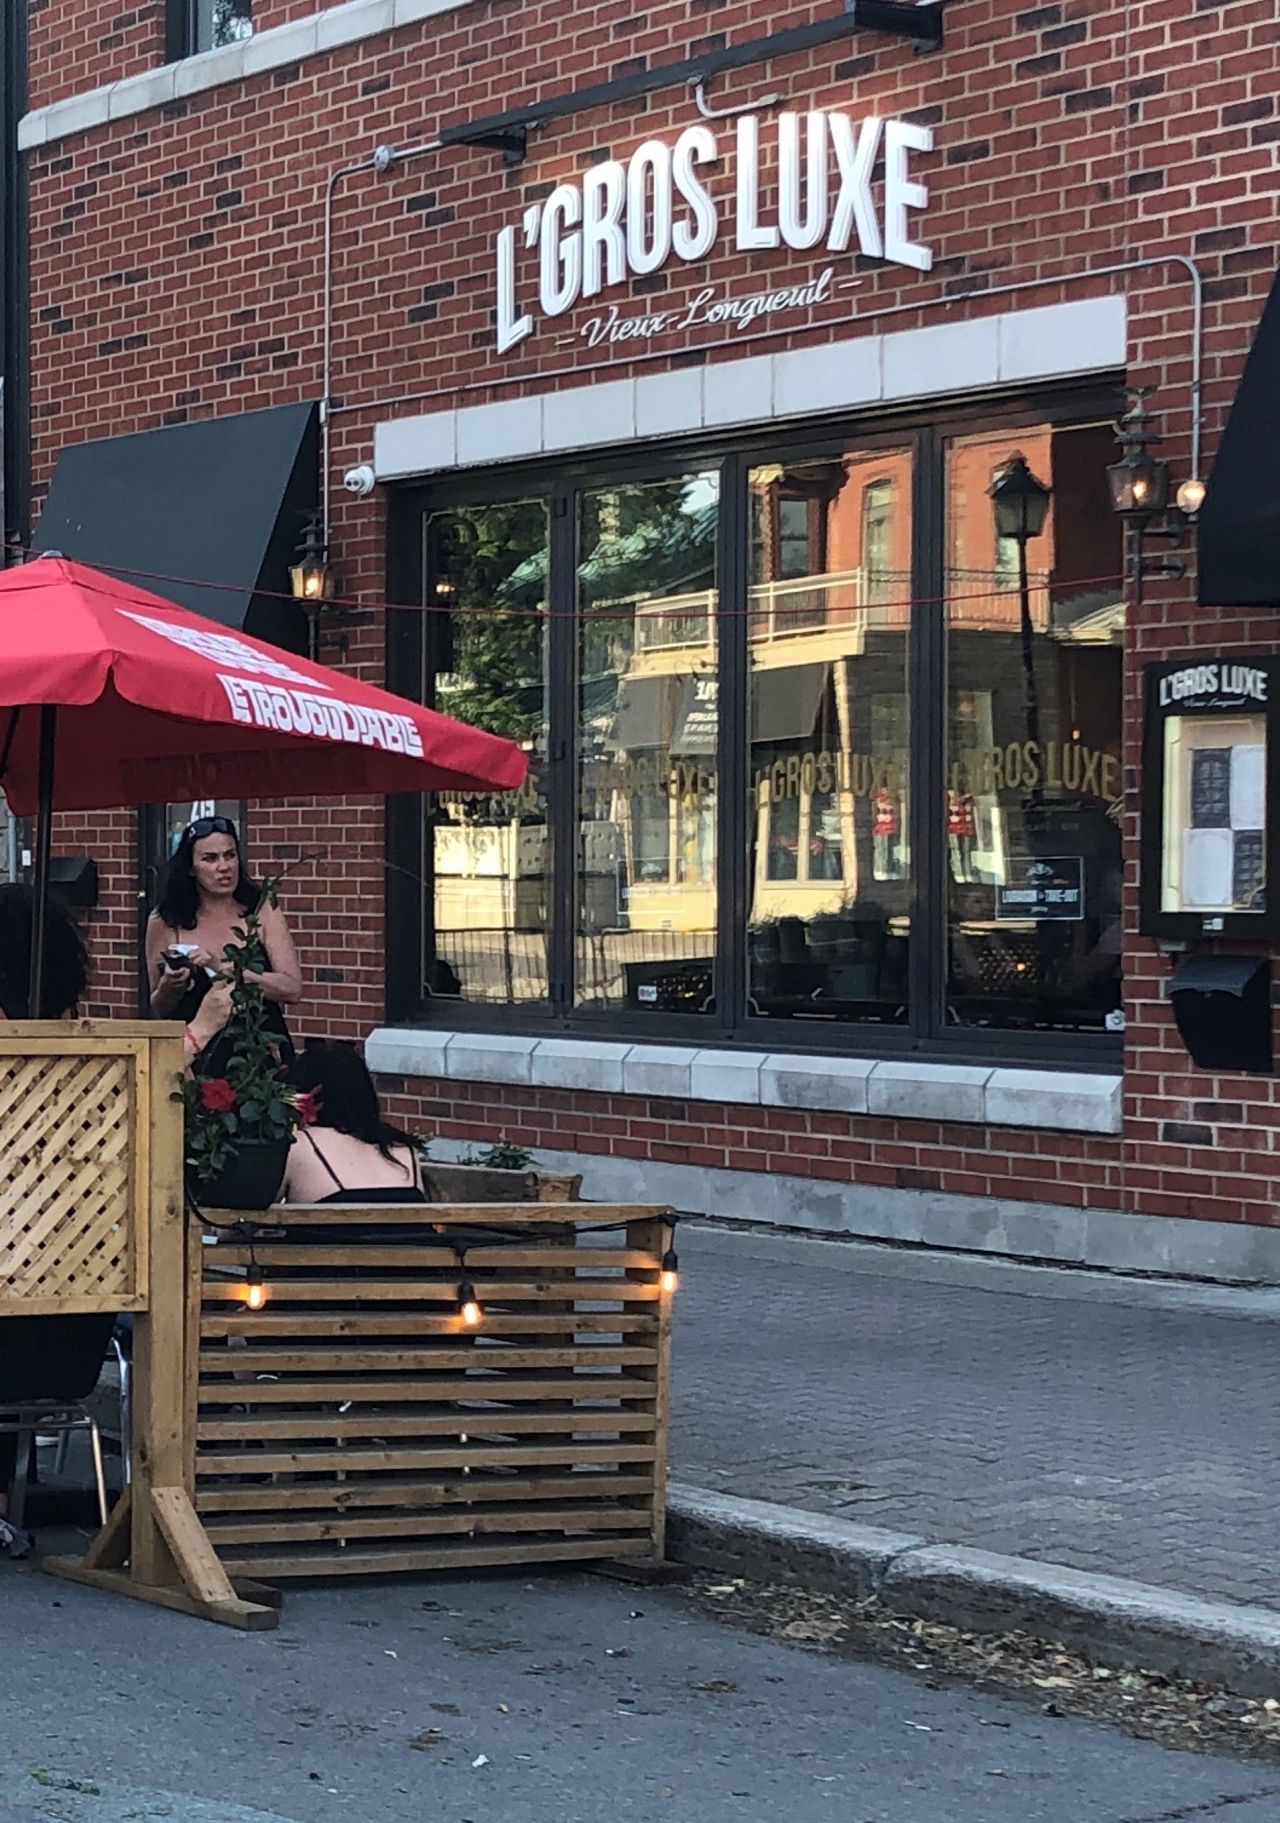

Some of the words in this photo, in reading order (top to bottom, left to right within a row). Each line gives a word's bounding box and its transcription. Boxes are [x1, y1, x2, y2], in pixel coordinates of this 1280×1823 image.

[496, 125, 719, 354] L'GROS
[736, 111, 933, 271] LUXE
[1159, 664, 1219, 706] L'GROS
[1221, 664, 1268, 701] LUXE
[1047, 741, 1120, 802] LUXE
